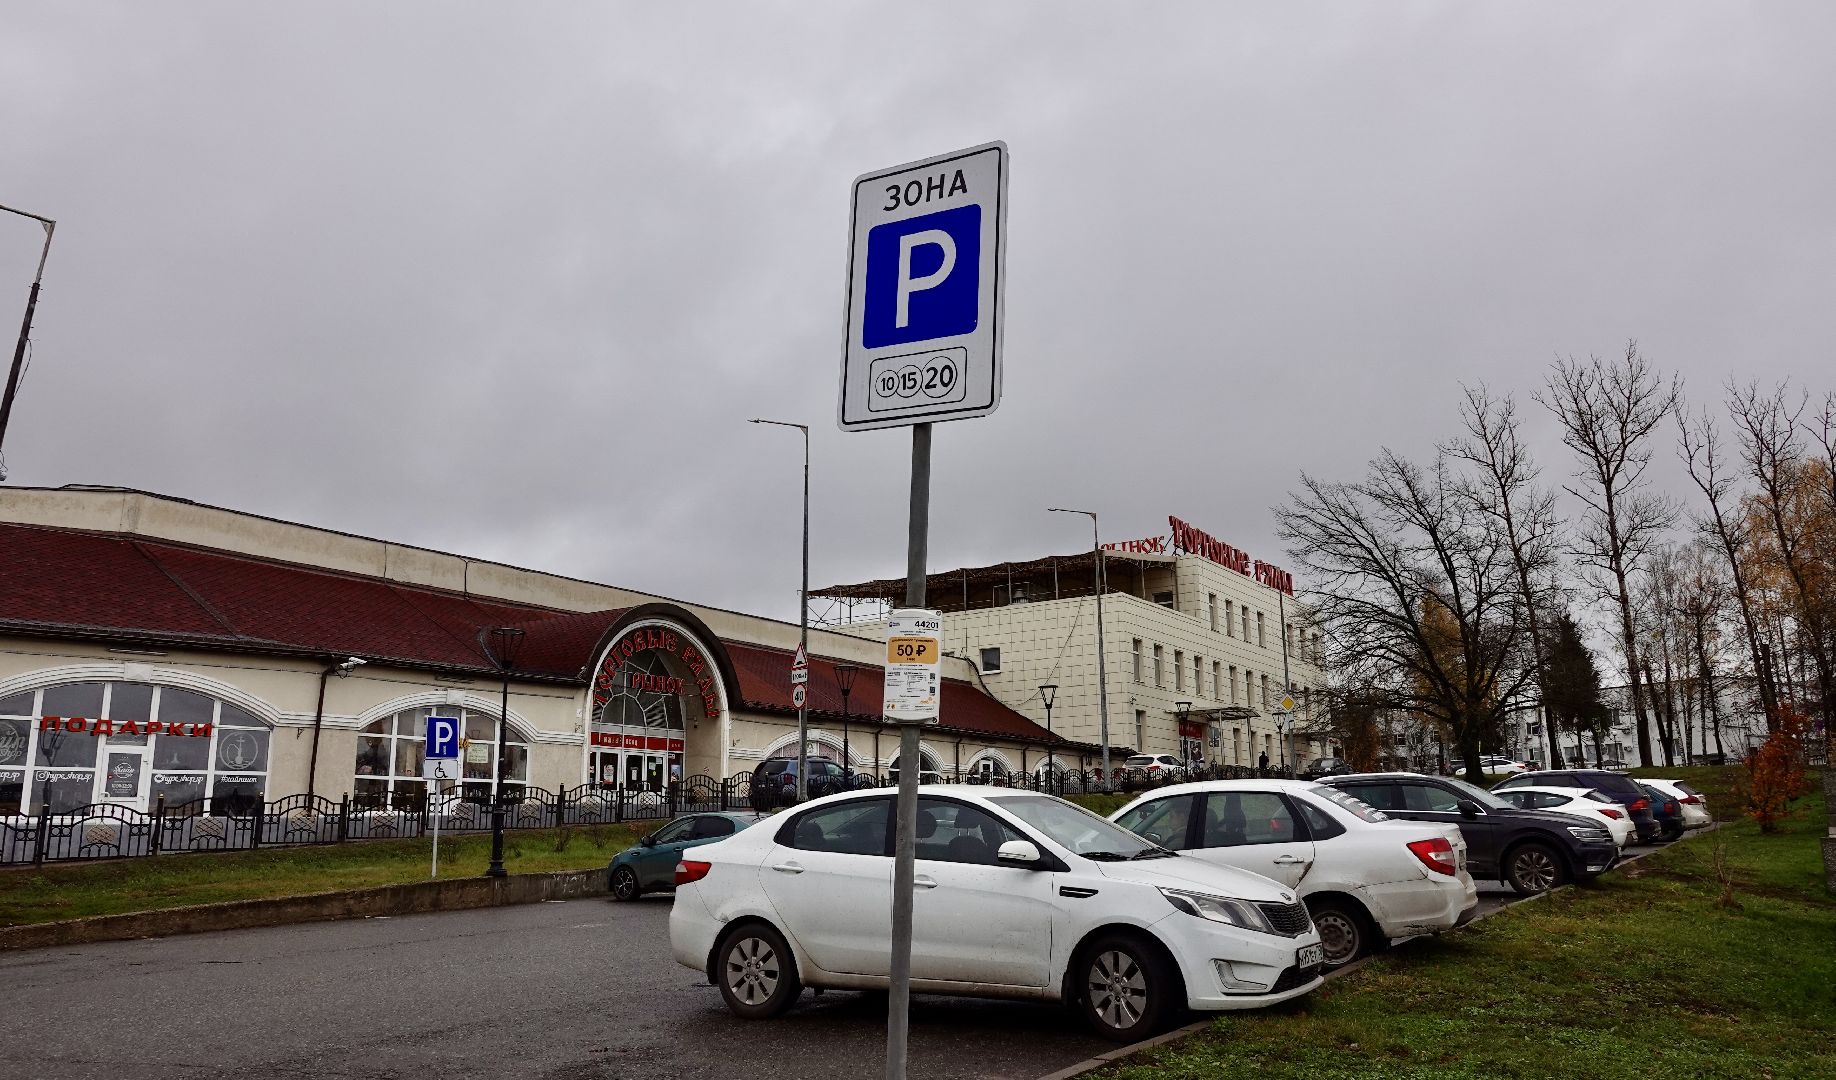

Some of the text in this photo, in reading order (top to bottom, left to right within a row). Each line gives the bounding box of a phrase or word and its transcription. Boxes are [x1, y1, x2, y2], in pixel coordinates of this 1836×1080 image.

[883, 169, 968, 211] ЗОНА
[895, 229, 957, 329] P
[880, 364, 954, 391] 10 15 20
[914, 620, 939, 629] 44201
[896, 644, 914, 657] 50
[592, 629, 678, 706] ТОРГОВЫЕ
[632, 671, 685, 696] РЫНОК
[794, 690, 804, 702] 40
[40, 716, 213, 737] ПОДАРКИ
[435, 721, 453, 754] P
